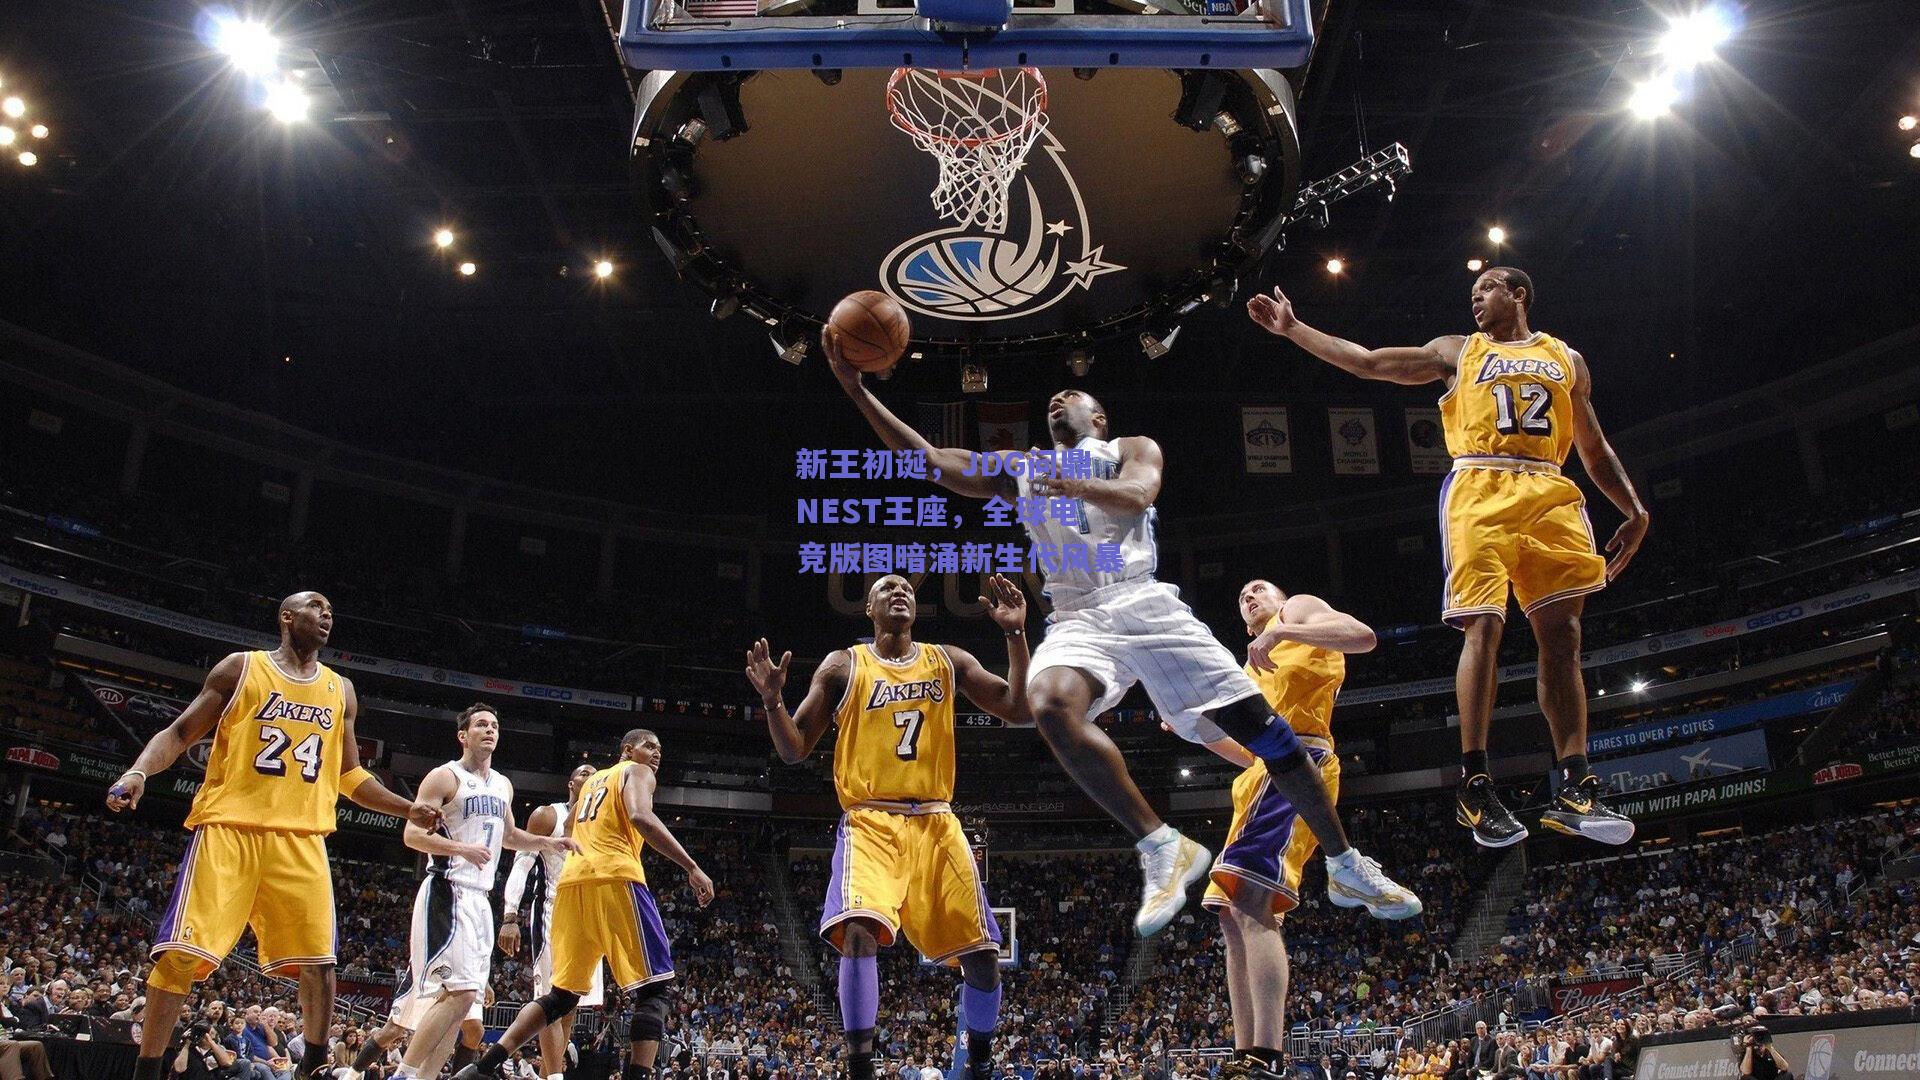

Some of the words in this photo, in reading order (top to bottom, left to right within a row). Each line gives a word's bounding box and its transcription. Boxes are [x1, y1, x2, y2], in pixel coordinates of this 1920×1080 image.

[1212, 2, 1233, 12] NBA
[1475, 353, 1566, 384] LAKERS
[1492, 383, 1552, 437] 12
[1747, 607, 1803, 629] GEICO
[101, 690, 119, 702] KIA
[522, 685, 572, 701] GEICO
[865, 679, 945, 710] LAKERS
[254, 692, 334, 730] LAKERS
[966, 715, 991, 726] 4:52
[893, 709, 924, 760] 7
[1593, 735, 1622, 751] FARES
[1624, 733, 1636, 745] TO
[1639, 728, 1665, 743] OVER
[1682, 719, 1715, 735] CITIES
[69, 752, 97, 766] Better
[253, 725, 323, 783] 24
[1867, 749, 1895, 762] Better
[1884, 758, 1912, 769] Better
[79, 765, 106, 777] Better
[577, 787, 609, 822] 17
[1618, 800, 1644, 815] WIN
[1648, 795, 1680, 812] WITH
[1684, 788, 1716, 805] PAPA
[1719, 778, 1766, 801] JOHNS!
[355, 813, 400, 829] JOHNS!
[482, 822, 495, 847] 7
[1658, 1062, 1699, 1080] Connect
[1700, 1063, 1713, 1078] at
